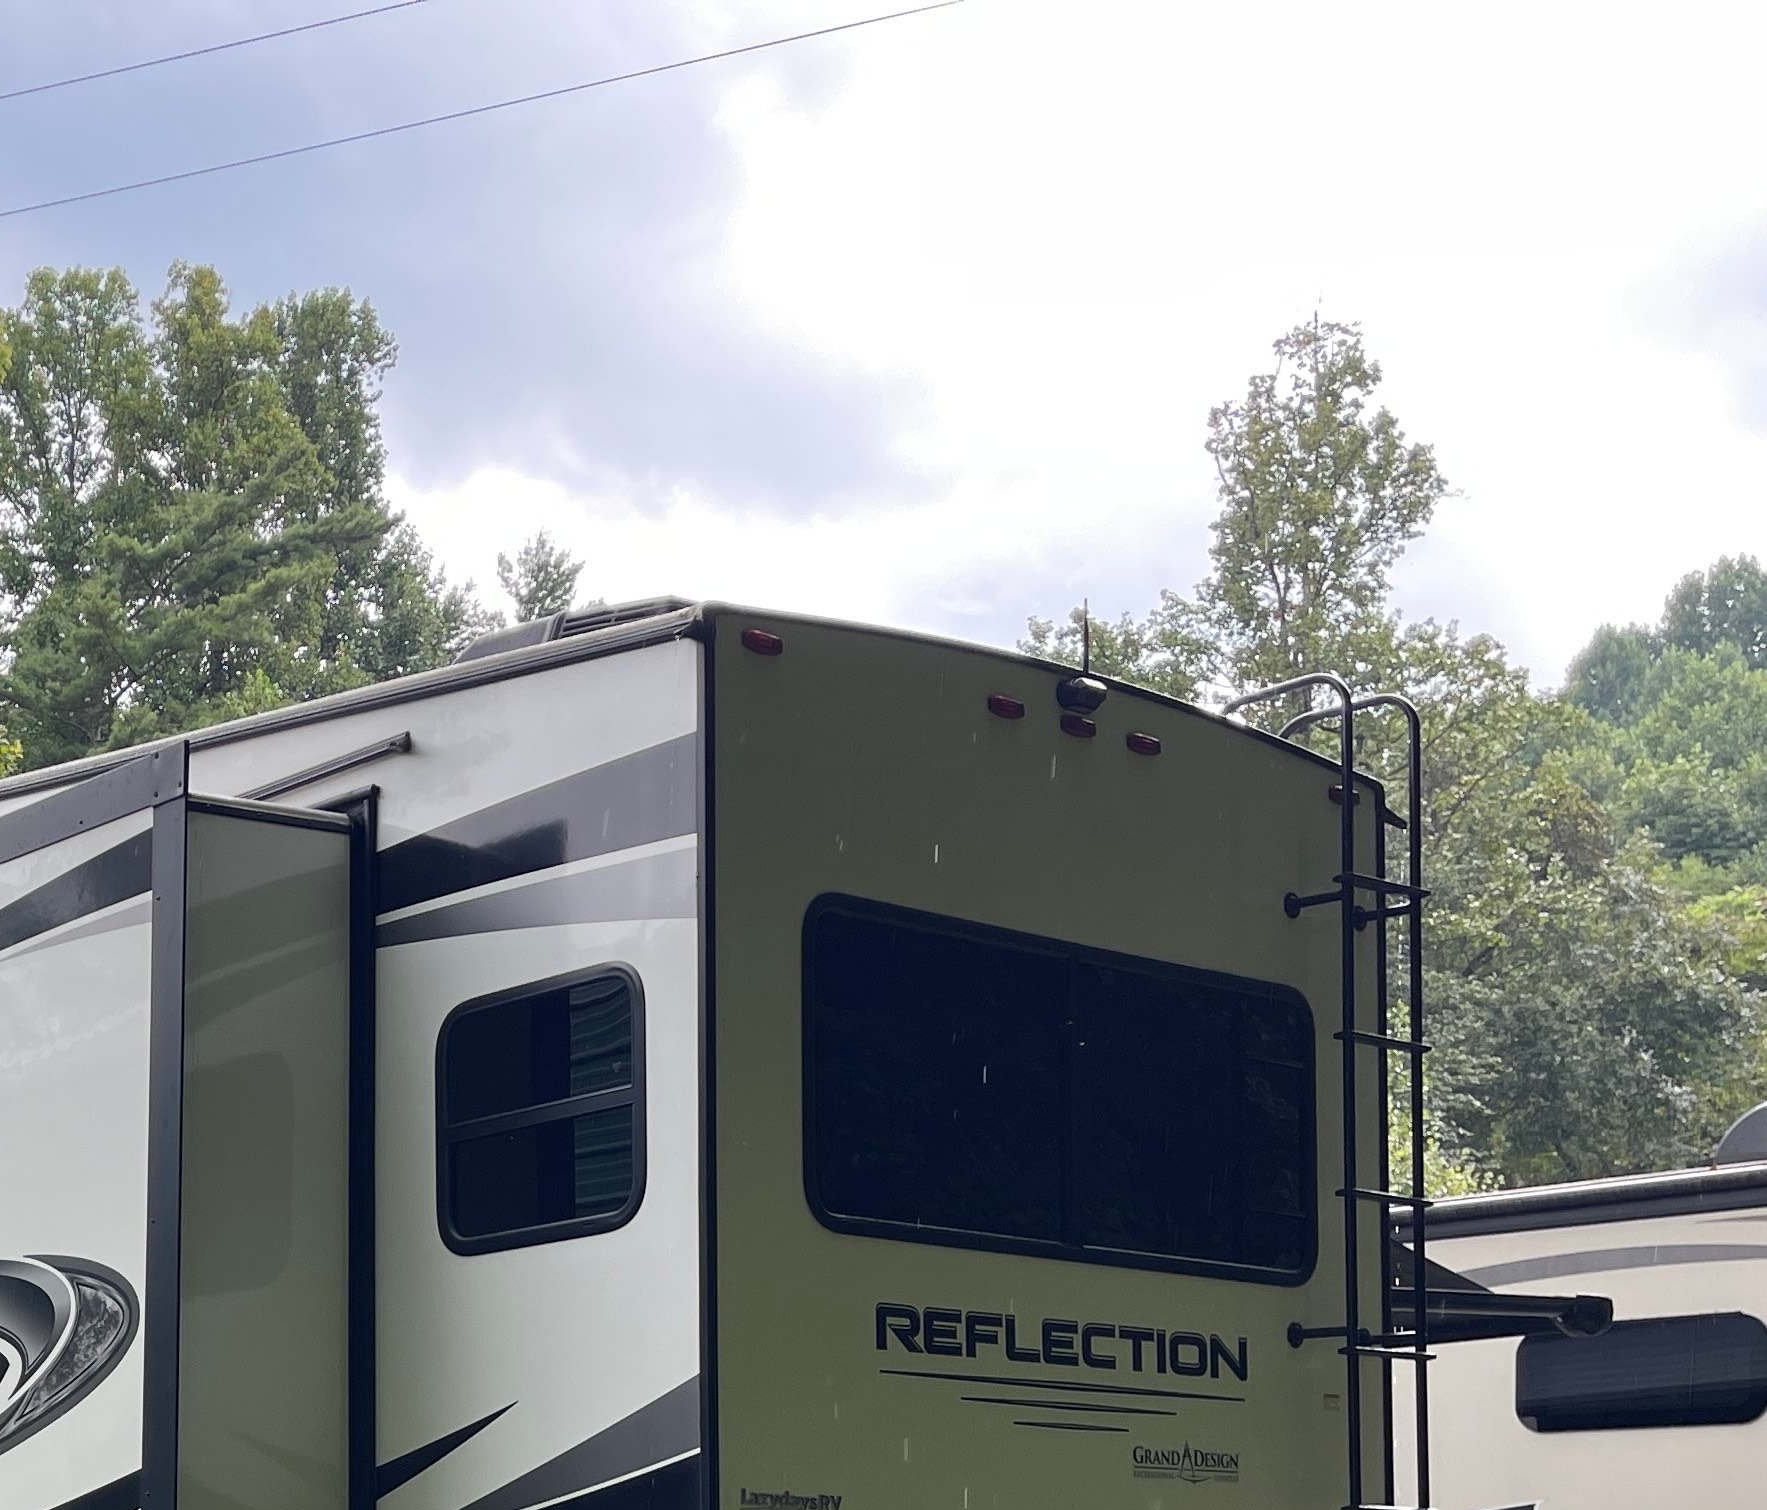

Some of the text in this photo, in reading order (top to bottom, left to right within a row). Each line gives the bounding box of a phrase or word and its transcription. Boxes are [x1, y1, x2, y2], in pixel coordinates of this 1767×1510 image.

[875, 1302, 1248, 1381] REFLECTION
[1132, 1446, 1239, 1469] GRAND DESIGN
